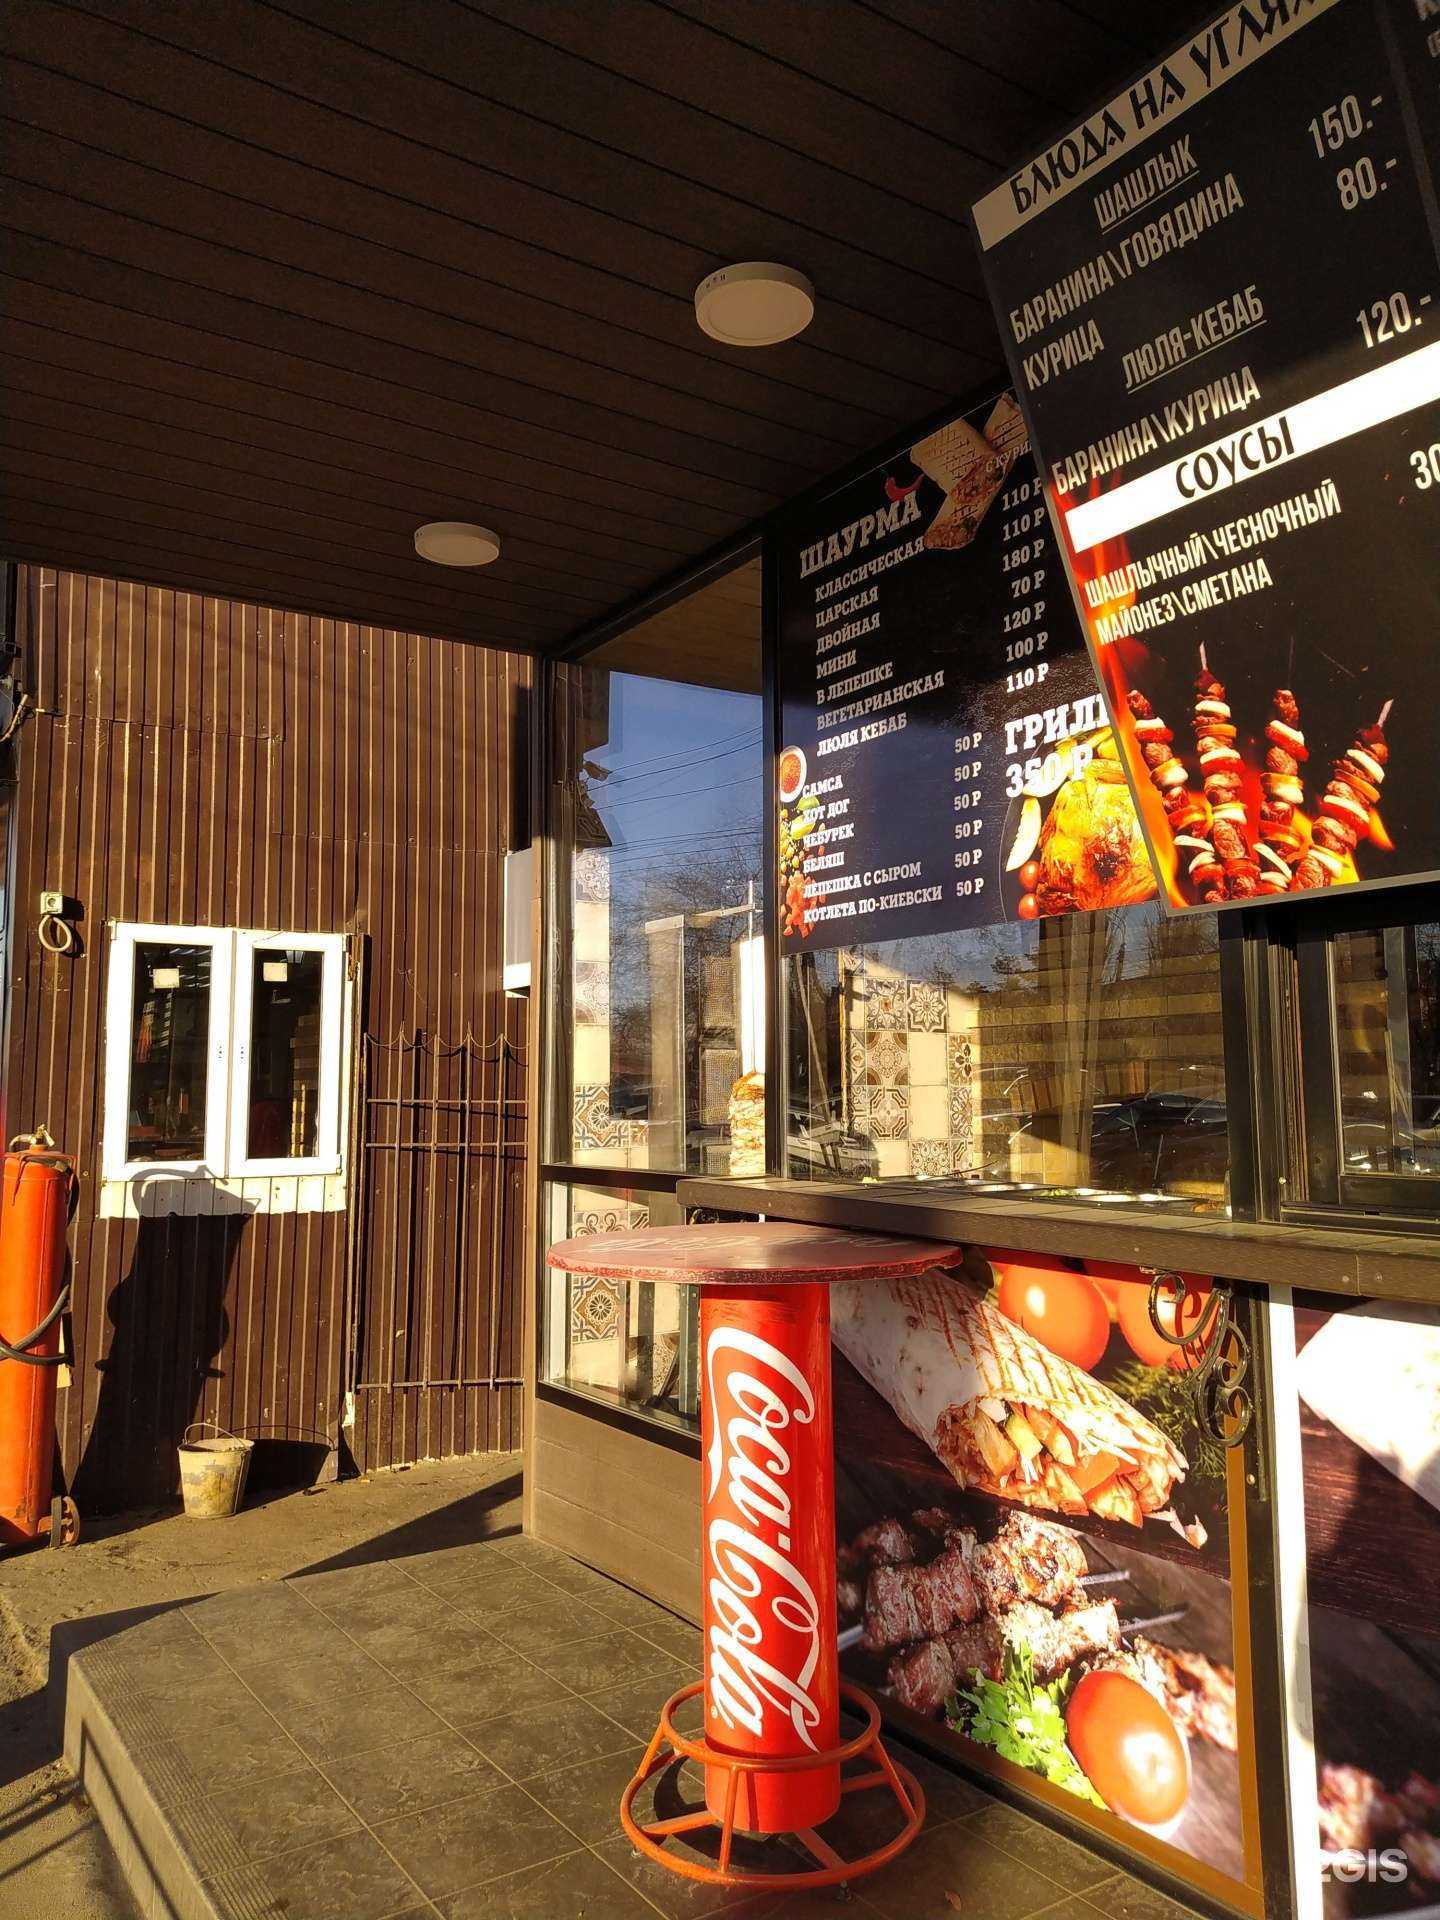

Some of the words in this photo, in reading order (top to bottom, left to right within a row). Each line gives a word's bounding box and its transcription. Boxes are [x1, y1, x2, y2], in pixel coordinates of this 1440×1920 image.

[1009, 108, 1126, 214] БЛЮДА
[1128, 65, 1186, 129] НА
[1307, 94, 1383, 159] 150.-
[1094, 135, 1198, 229] ШАШЛЫК
[1335, 156, 1397, 210] 80.-
[1122, 285, 1265, 388] ЛЮЛЯ-КЕБАБ
[1356, 291, 1432, 349] 120.-
[1022, 319, 1105, 391] КУРИЦА
[995, 440, 1032, 475] КУРИ
[1175, 416, 1296, 499] СОУСЫ
[1001, 486, 1030, 512] 110
[799, 489, 922, 580] ШАУРМА
[1002, 516, 1030, 543] 110
[815, 536, 925, 602] КЛАССИЧЕСКАЯ
[1002, 546, 1031, 573] 180
[1011, 577, 1031, 600] 70
[815, 585, 880, 630] ЦАРСКАЯ
[1003, 608, 1031, 633] 120
[815, 612, 881, 656] ДВОЙНАЯ
[1005, 637, 1034, 663] 100
[816, 649, 857, 680] МИНИ
[1006, 668, 1036, 694] 110
[816, 690, 825, 706] В
[826, 661, 894, 702] ЛЕПЕШКЕ
[816, 670, 945, 731] ВЕГЕТАРИАНСКАЯ
[816, 729, 859, 757] ЛЮЛЯ
[861, 711, 908, 744] КЕБАБ
[954, 736, 971, 754] 50
[802, 775, 843, 798] САМСА
[954, 766, 971, 783] 50
[1005, 751, 1061, 798] 350
[803, 805, 826, 824] ХОТ
[827, 799, 850, 820] ДОГ
[953, 795, 970, 811] 50
[802, 823, 855, 848] ЧЕБУРЕК
[954, 823, 971, 840] 50
[802, 852, 845, 874] БЕЛЯШ
[954, 852, 971, 868] 50
[803, 874, 862, 898] ЛЕПЕШКА
[863, 870, 872, 886] С
[873, 862, 922, 886] СЫРОМ
[956, 881, 973, 897] 50
[803, 899, 856, 924] КОТЛЕТА
[858, 885, 943, 914] ПО-КИЕВСКИ
[706, 1326, 822, 1754] Coca-Cola
